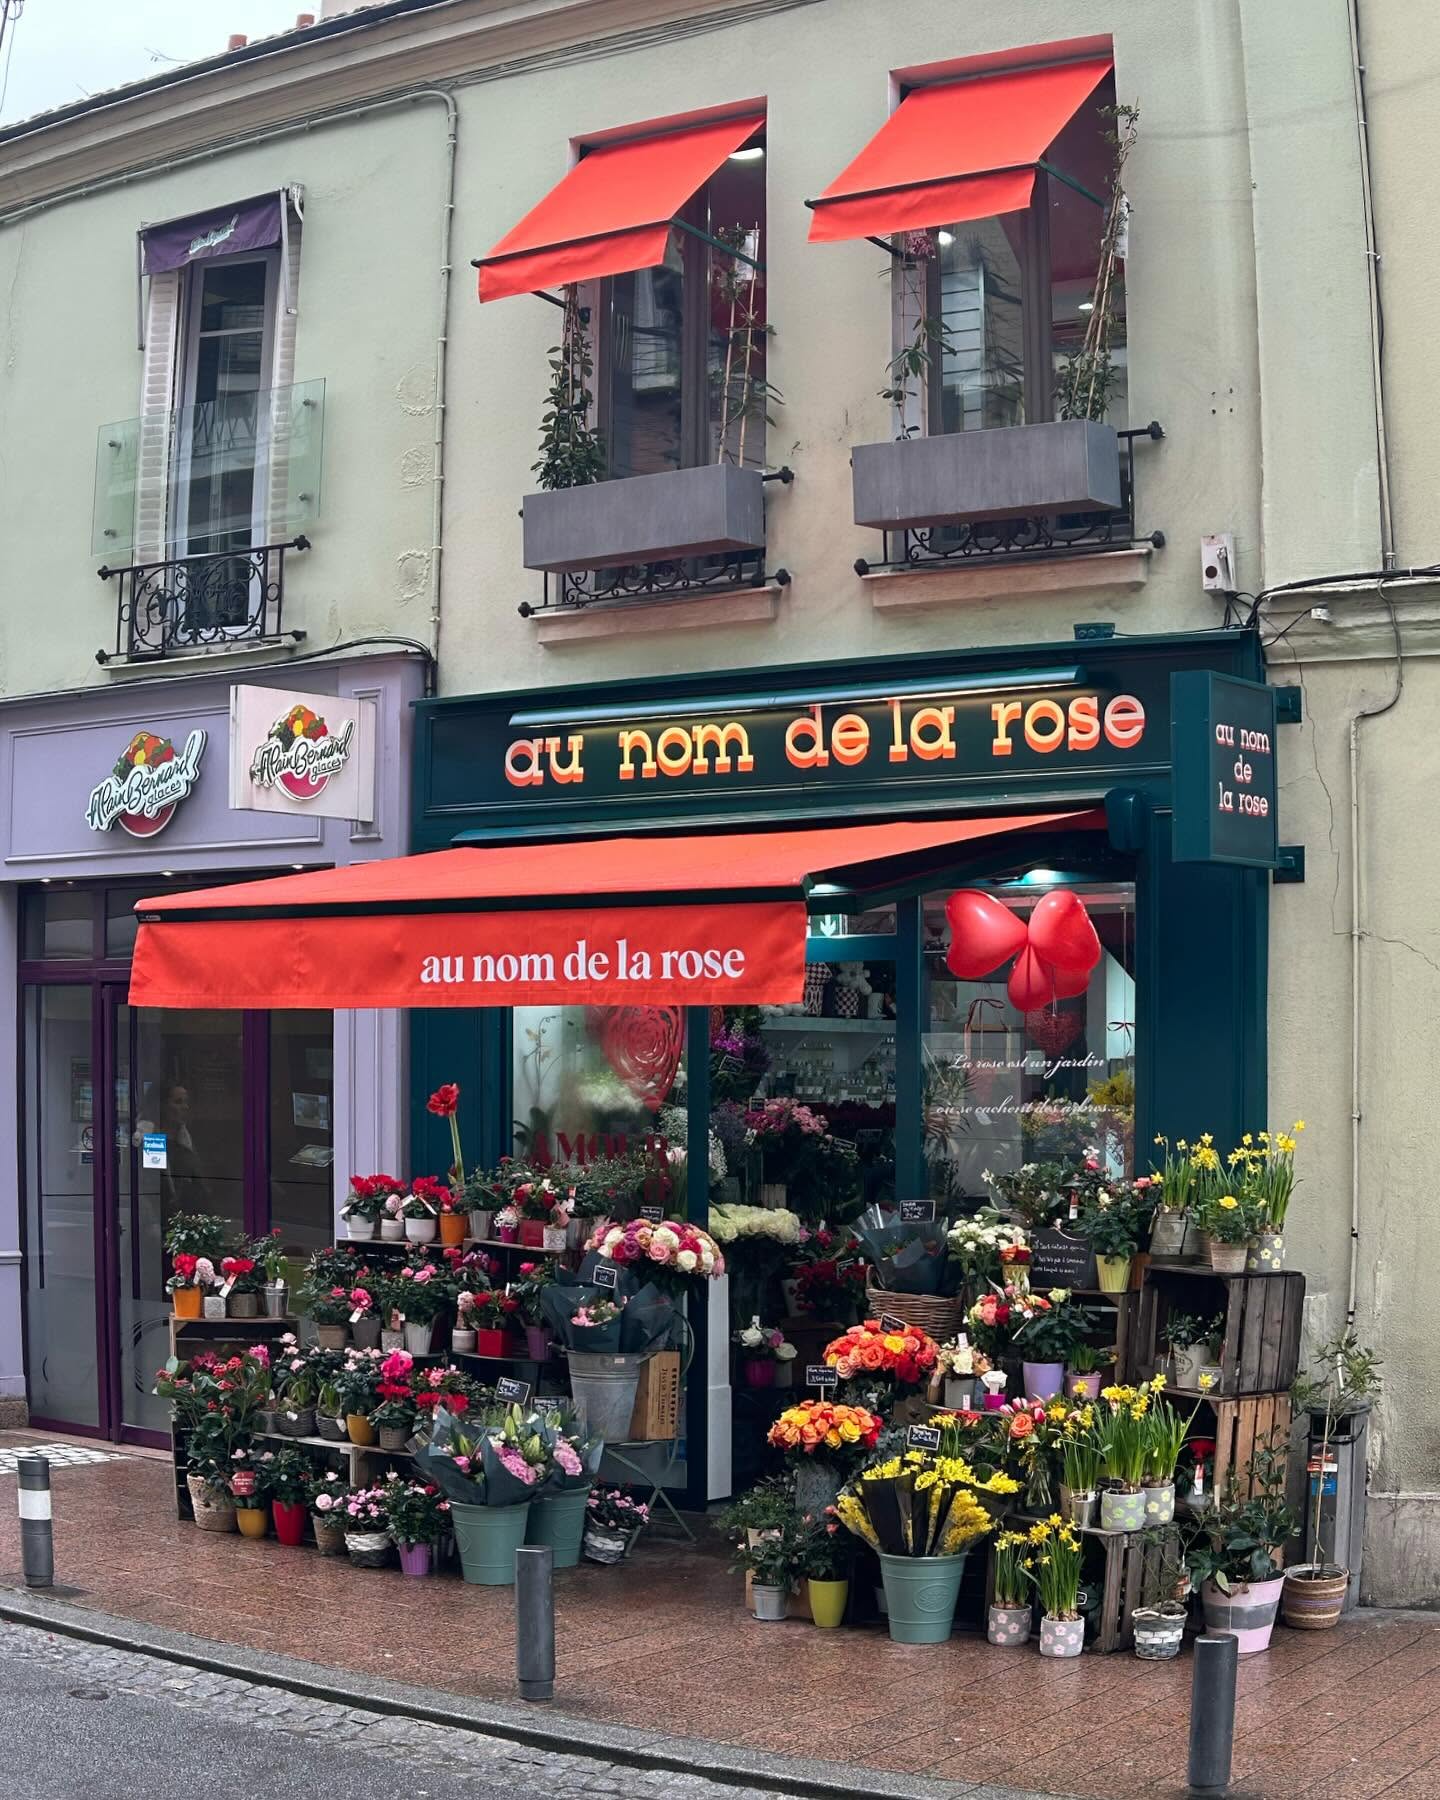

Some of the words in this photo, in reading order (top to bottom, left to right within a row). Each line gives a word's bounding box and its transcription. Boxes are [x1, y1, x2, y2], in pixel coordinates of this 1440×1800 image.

[294, 721, 354, 776] Bernard
[505, 735, 584, 787] au
[618, 721, 754, 780] nom
[786, 704, 870, 768] de
[889, 698, 957, 763] la
[991, 694, 1146, 756] rose
[1215, 723, 1235, 747] au
[1240, 728, 1271, 754] nom
[127, 734, 196, 811] Bernard
[312, 758, 342, 783] glaces
[1233, 754, 1253, 784] de
[146, 780, 183, 815] glaces
[1218, 781, 1234, 812] la
[1238, 792, 1269, 817] rose
[420, 955, 465, 984] au
[471, 953, 556, 983] nom
[563, 939, 610, 981] de
[616, 938, 653, 981] la
[660, 948, 745, 980] rose
[948, 1053, 972, 1070] La
[975, 1059, 1004, 1069] rose
[1006, 1056, 1028, 1069] est
[1029, 1059, 1052, 1069] un
[1043, 1051, 1105, 1080] jardin
[975, 1094, 1034, 1115] cachent
[1034, 1097, 1058, 1115] des
